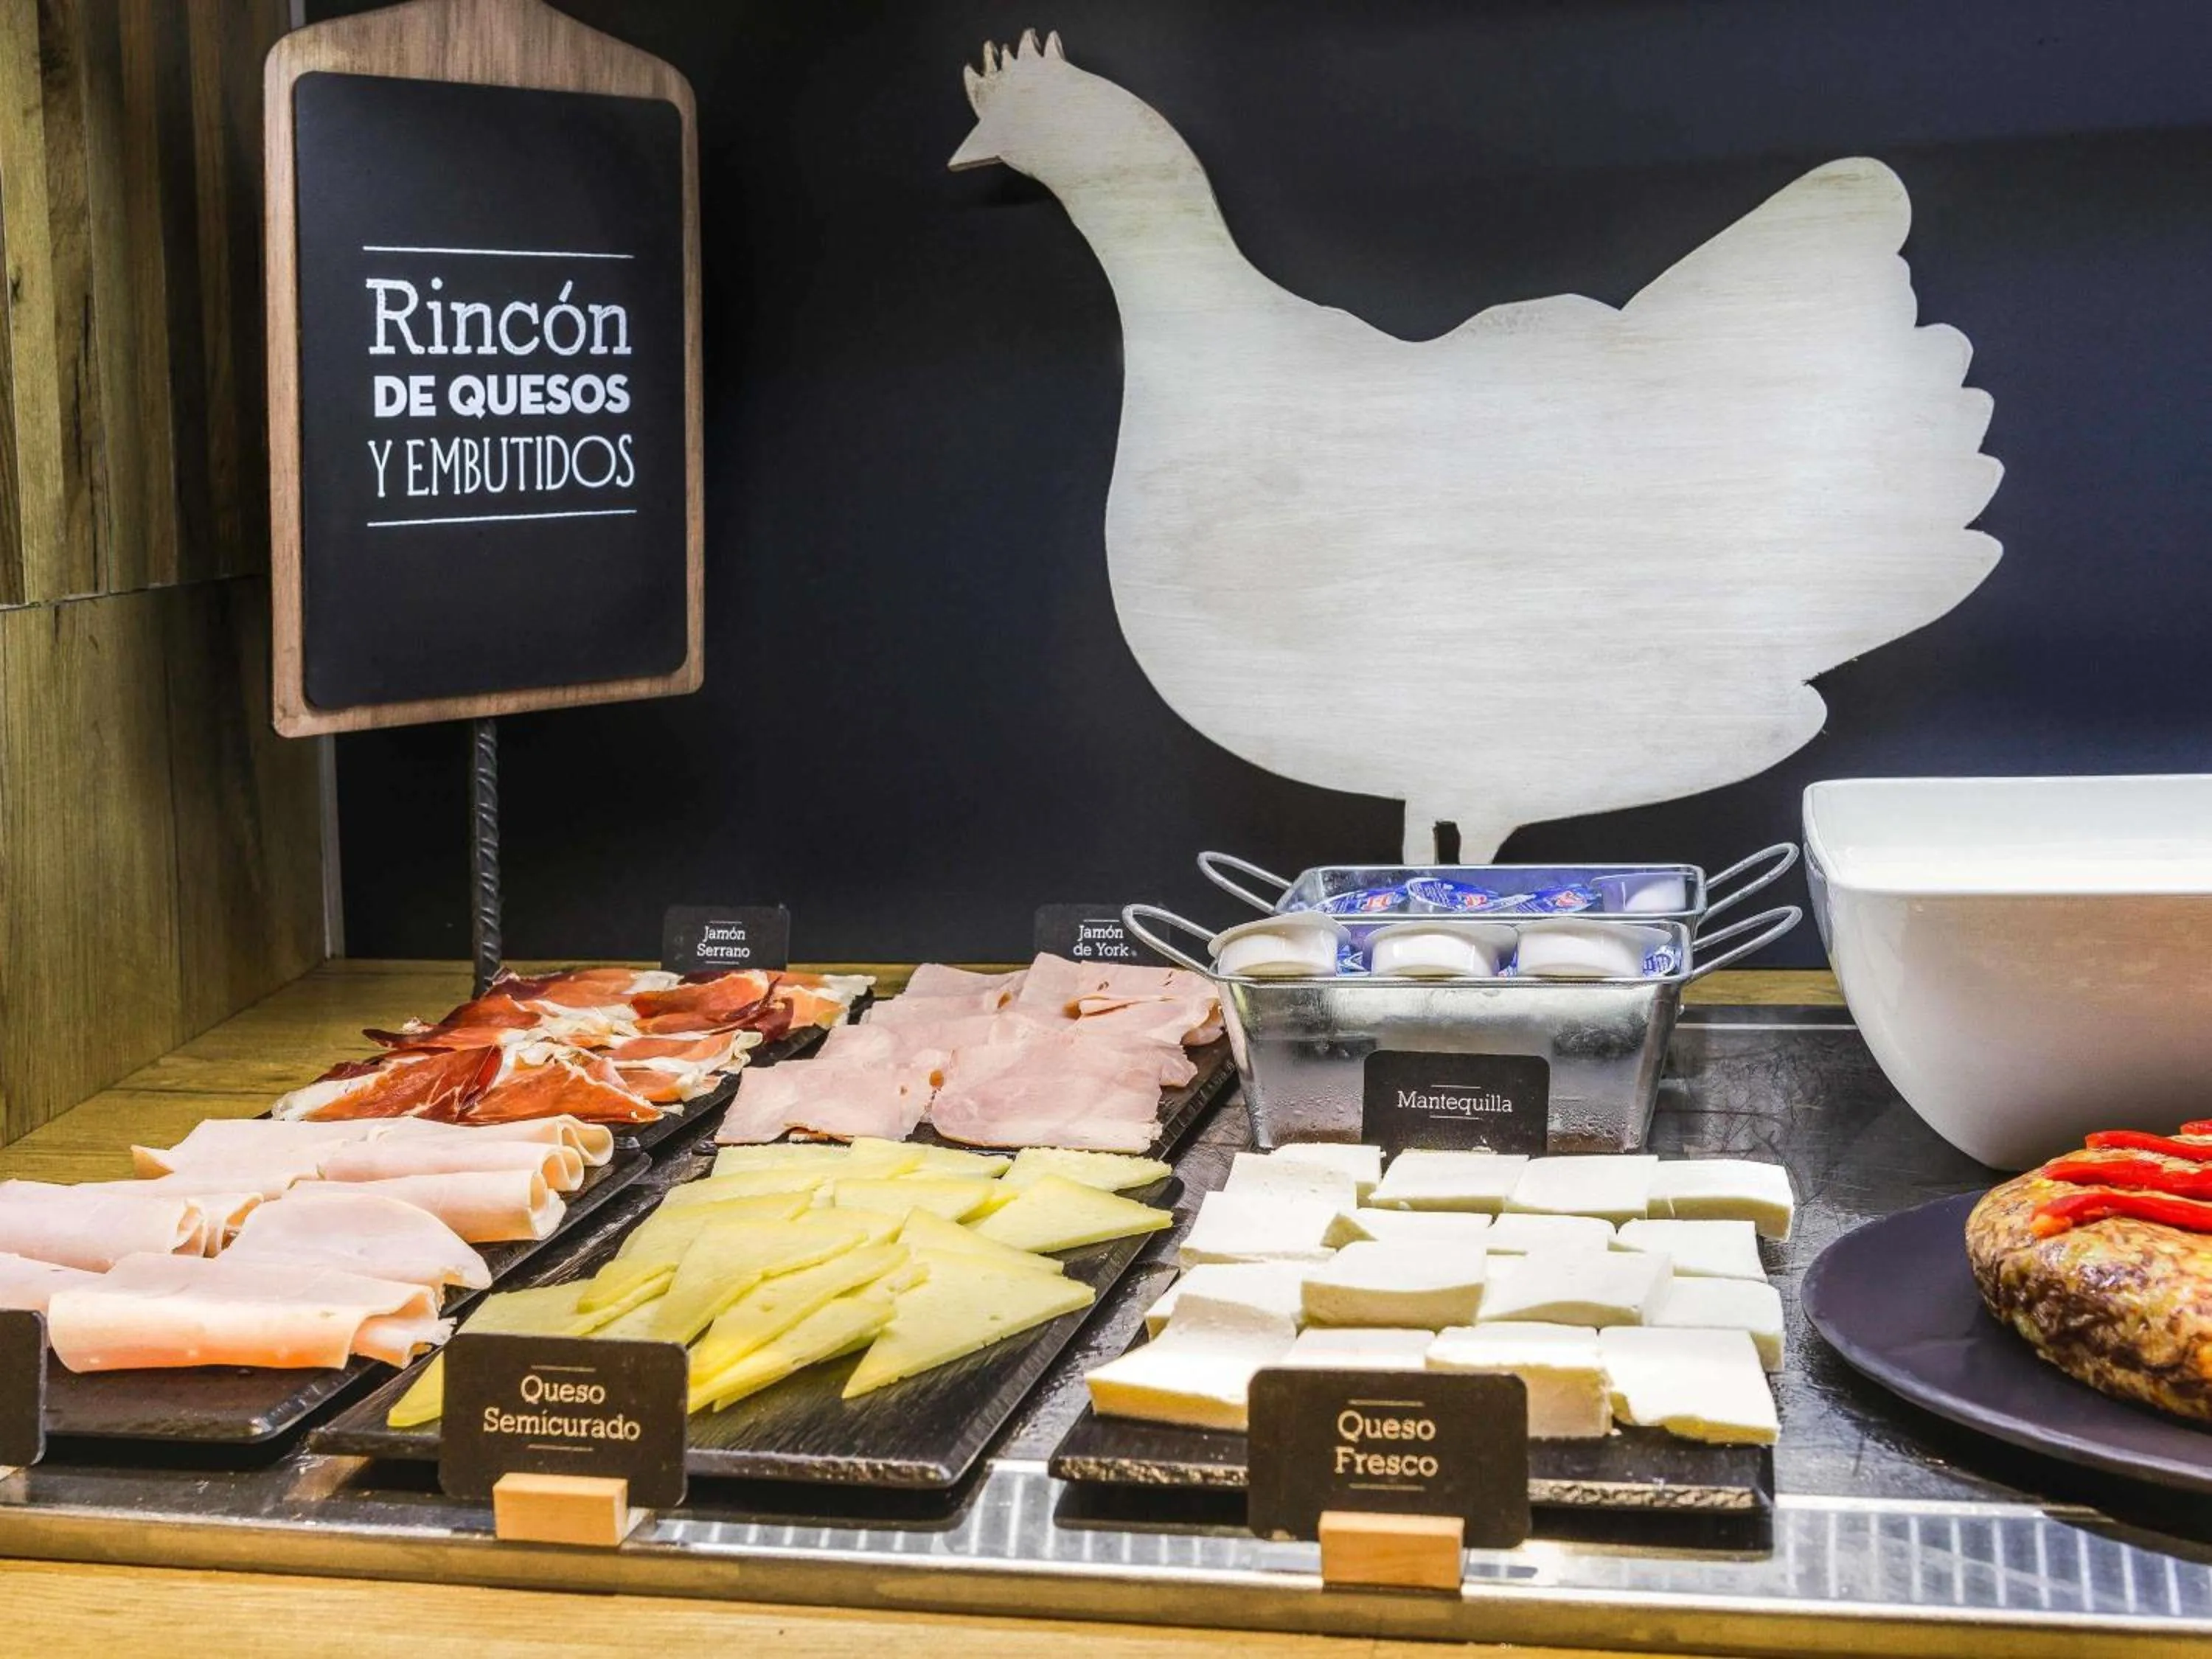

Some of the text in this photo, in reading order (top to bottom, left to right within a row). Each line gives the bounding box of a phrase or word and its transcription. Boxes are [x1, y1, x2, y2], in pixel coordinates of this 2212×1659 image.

[366, 277, 632, 356] Rincón
[375, 374, 630, 419] DE QUESOS
[368, 434, 635, 498] Y EMBUTIDOS
[702, 925, 746, 943] Jamón
[1077, 924, 1124, 942] Jamón
[697, 943, 751, 958] Serrano
[1073, 942, 1130, 956] de York
[1397, 1091, 1513, 1116] Mantequilla
[521, 1374, 605, 1404] Queso
[1338, 1410, 1436, 1443] Queso
[1334, 1446, 1439, 1477] Fresco
